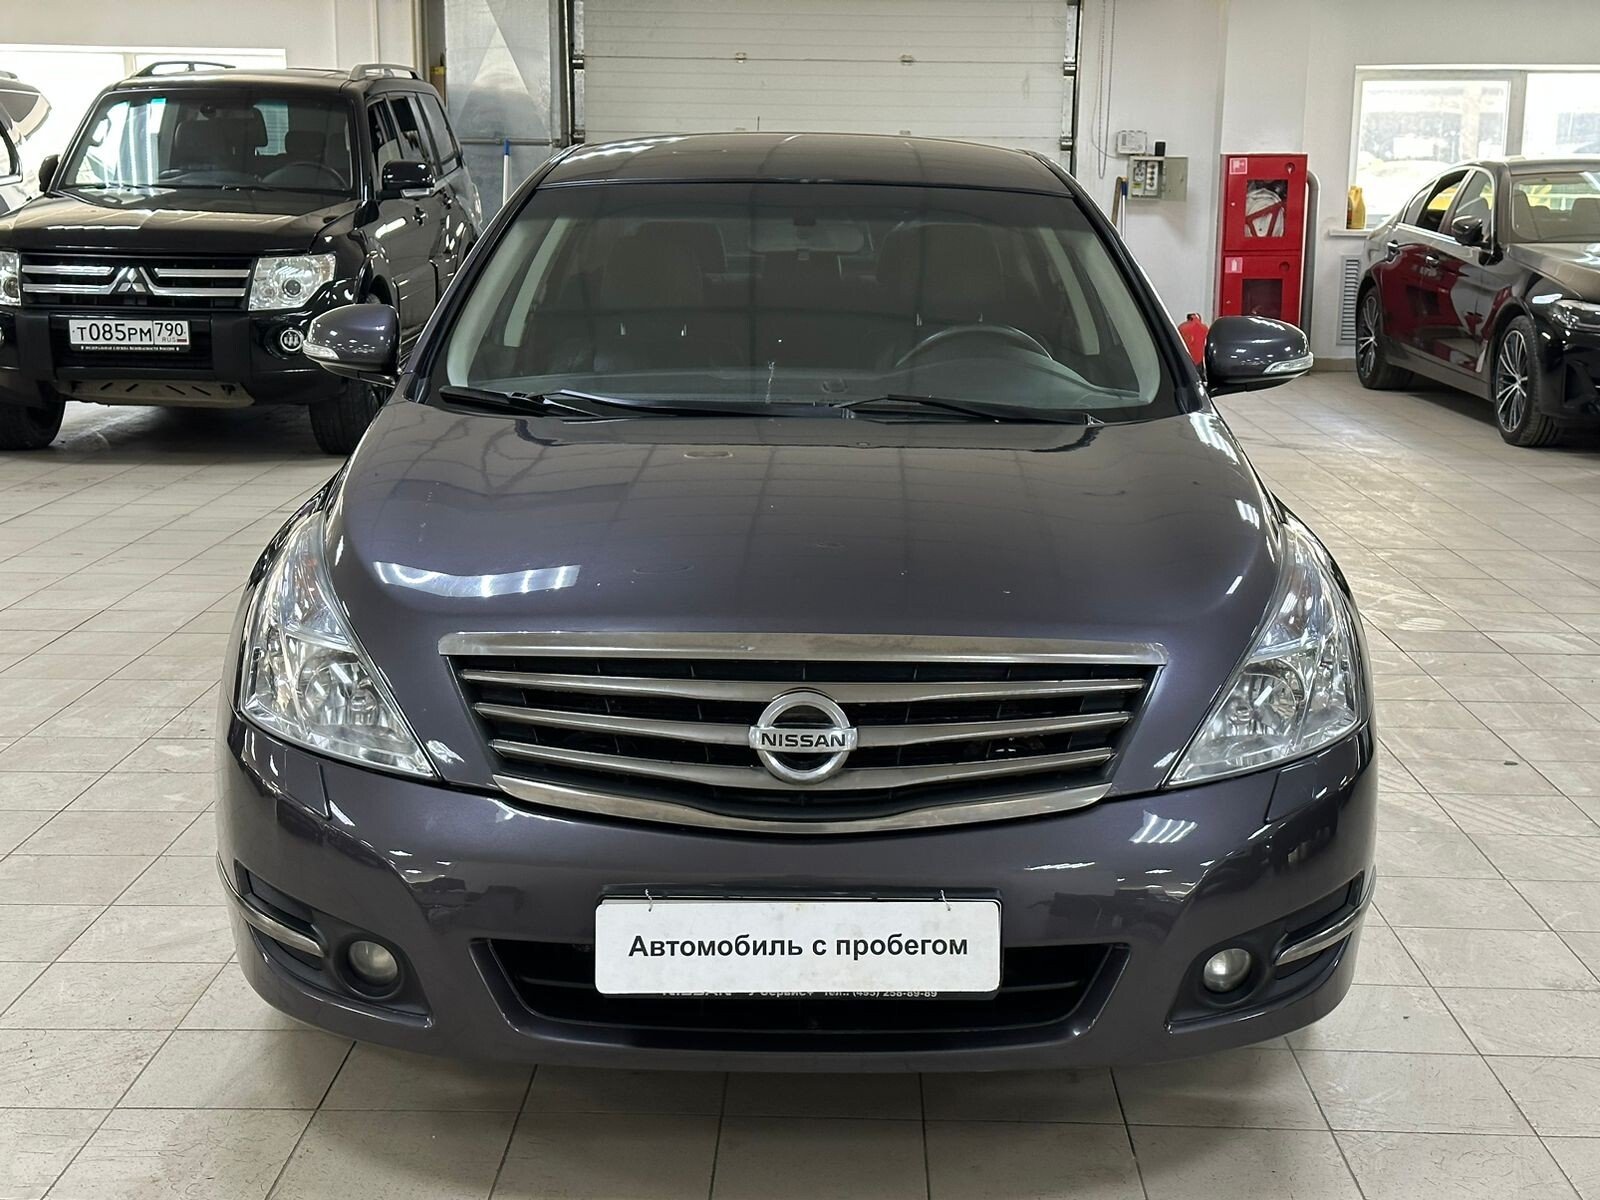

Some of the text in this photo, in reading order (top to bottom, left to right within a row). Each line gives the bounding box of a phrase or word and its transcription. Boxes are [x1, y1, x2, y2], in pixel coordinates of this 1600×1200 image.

[77, 322, 183, 342] Т085РМ 790
[761, 732, 846, 748] NISSAN
[628, 934, 968, 961] Автомобиль с пробегом
